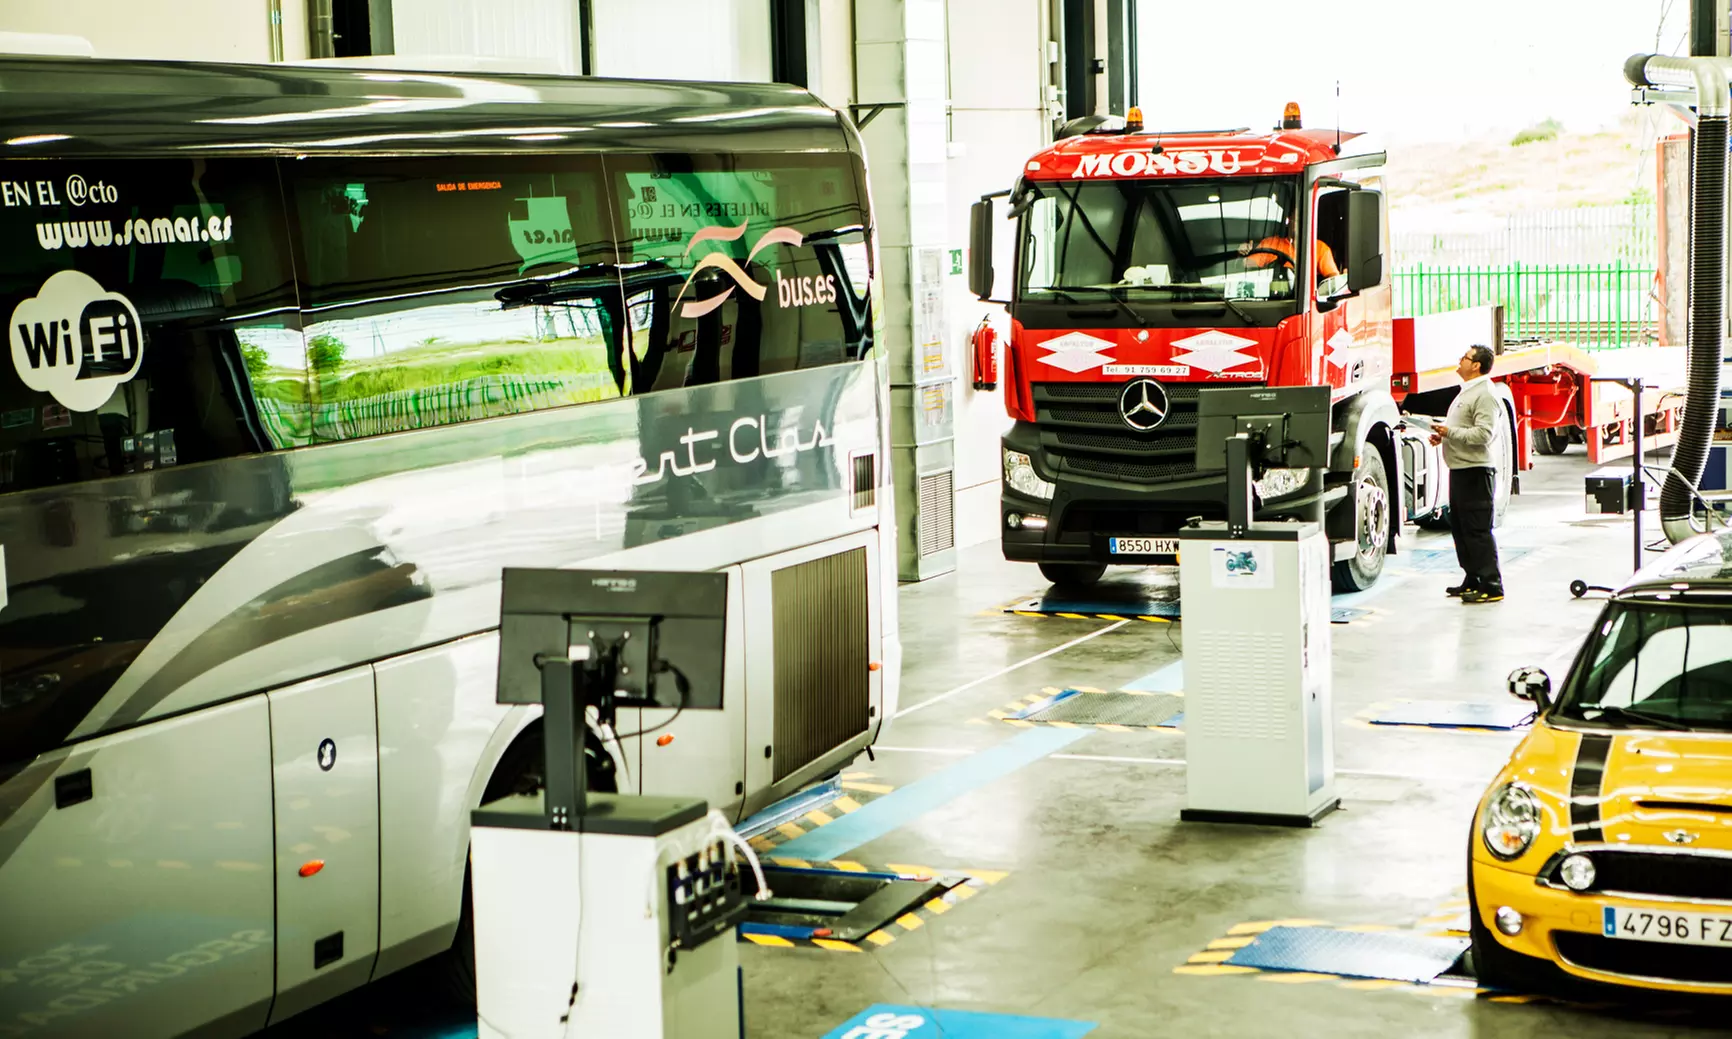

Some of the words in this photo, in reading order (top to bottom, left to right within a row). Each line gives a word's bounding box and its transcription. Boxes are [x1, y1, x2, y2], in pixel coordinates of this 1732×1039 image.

[1071, 150, 1242, 179] MONSU
[1, 180, 32, 207] EN
[36, 179, 61, 206] EL
[66, 173, 118, 207] @cto
[436, 183, 456, 192] SALIDA
[457, 182, 466, 191] DE
[36, 215, 232, 250] www.samar.es
[776, 268, 837, 308] bus.es
[1106, 365, 1121, 374] Tel.
[1124, 366, 1136, 374] 91
[1140, 366, 1157, 374] 759
[1160, 366, 1172, 374] 69
[1175, 366, 1187, 374] 27
[1118, 539, 1151, 553] 8550
[1623, 912, 1690, 939] 4796
[1700, 917, 1732, 942] FZ
